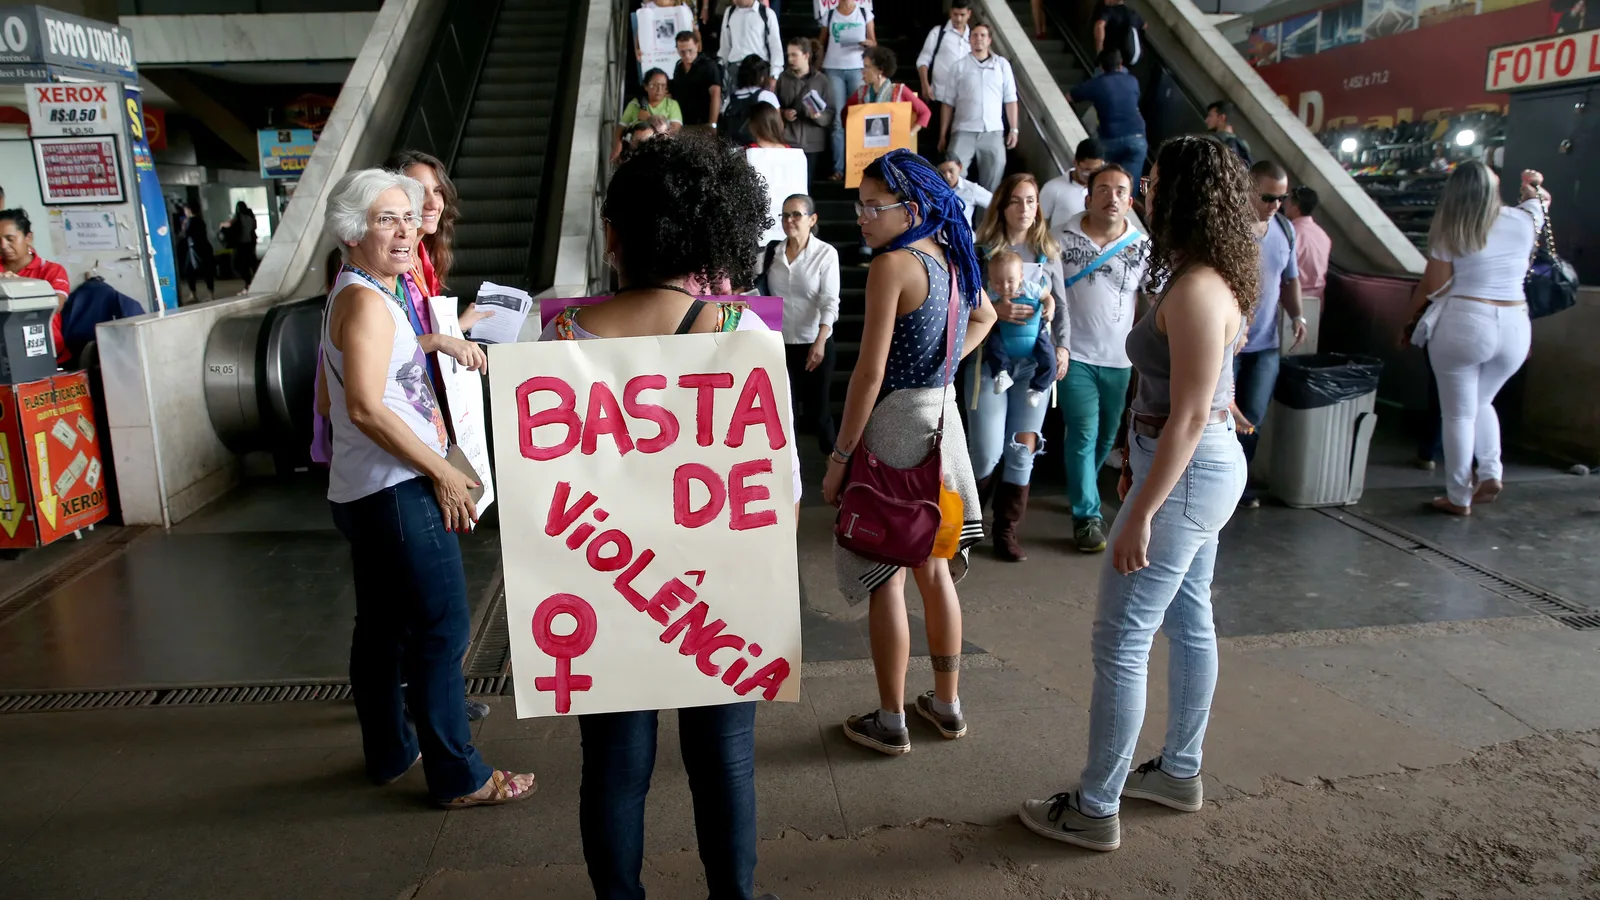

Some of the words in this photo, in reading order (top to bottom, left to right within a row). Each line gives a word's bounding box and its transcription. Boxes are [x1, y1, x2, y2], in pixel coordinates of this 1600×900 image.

[45, 18, 89, 59] FOTO
[86, 26, 132, 68] UNIÃO
[1492, 38, 1577, 87] FOTO
[37, 86, 108, 103] XEROX
[281, 158, 308, 171] CELU
[222, 365, 234, 374] 05
[516, 367, 787, 461] BASTA
[673, 458, 778, 530] DE
